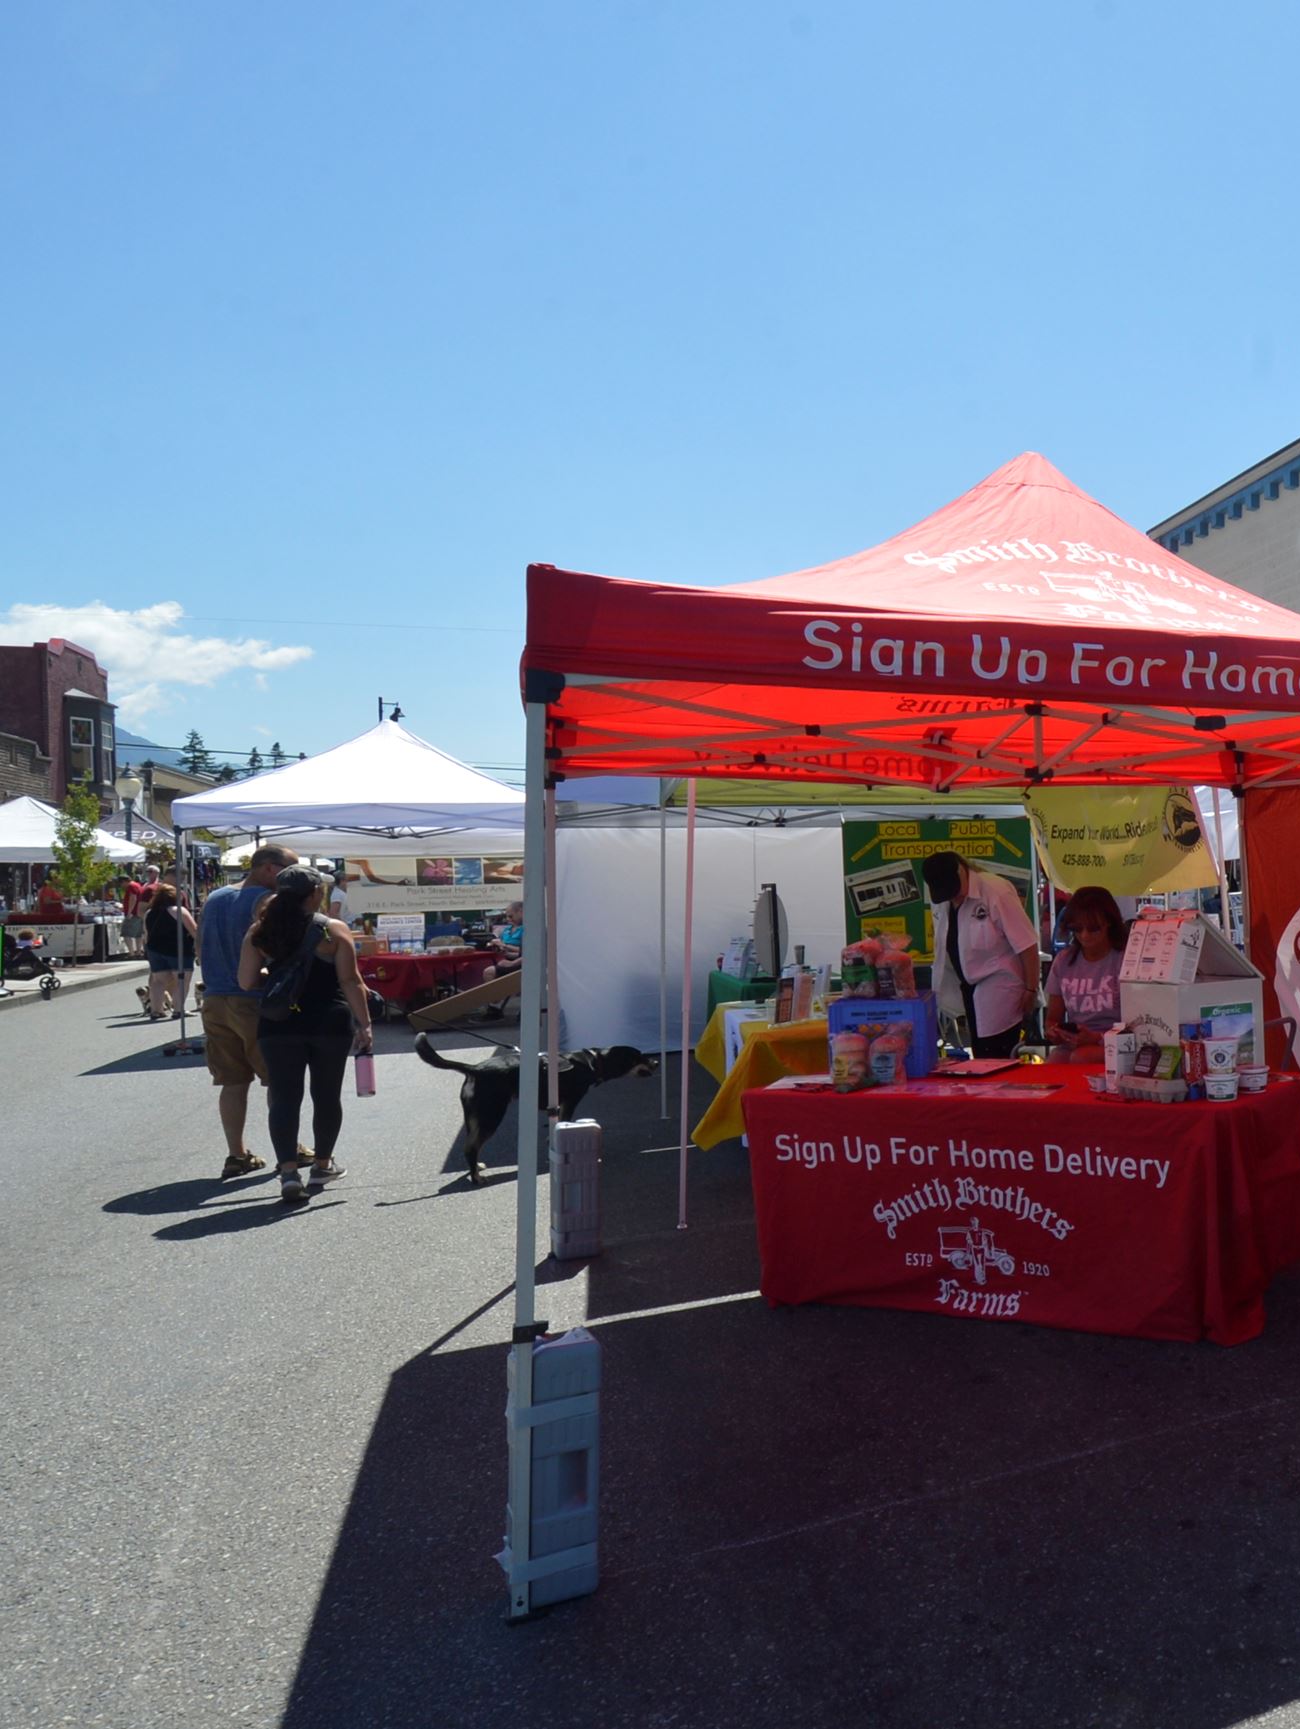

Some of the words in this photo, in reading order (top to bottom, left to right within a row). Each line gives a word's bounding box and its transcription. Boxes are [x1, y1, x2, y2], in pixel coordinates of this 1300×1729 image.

[904, 536, 1060, 574] Smith
[1058, 540, 1271, 613] Brothers
[802, 620, 946, 677] Sign
[971, 633, 1047, 684] Up
[1070, 642, 1167, 687] For
[878, 822, 921, 836] Local
[950, 822, 997, 836] Public
[1051, 824, 1086, 843] Expand
[407, 887, 425, 895] Park
[427, 886, 452, 894] Street
[1060, 975, 1113, 995] MILK
[775, 1134, 836, 1169] Sign
[842, 1136, 882, 1171] Up
[890, 1137, 939, 1167] For
[949, 1140, 1034, 1172] Home
[1044, 1143, 1170, 1189] Delivery
[872, 1176, 953, 1240] Smith
[954, 1176, 1075, 1241] Brothers
[1022, 1261, 1050, 1278] 1920
[935, 1277, 1022, 1317] Farms
